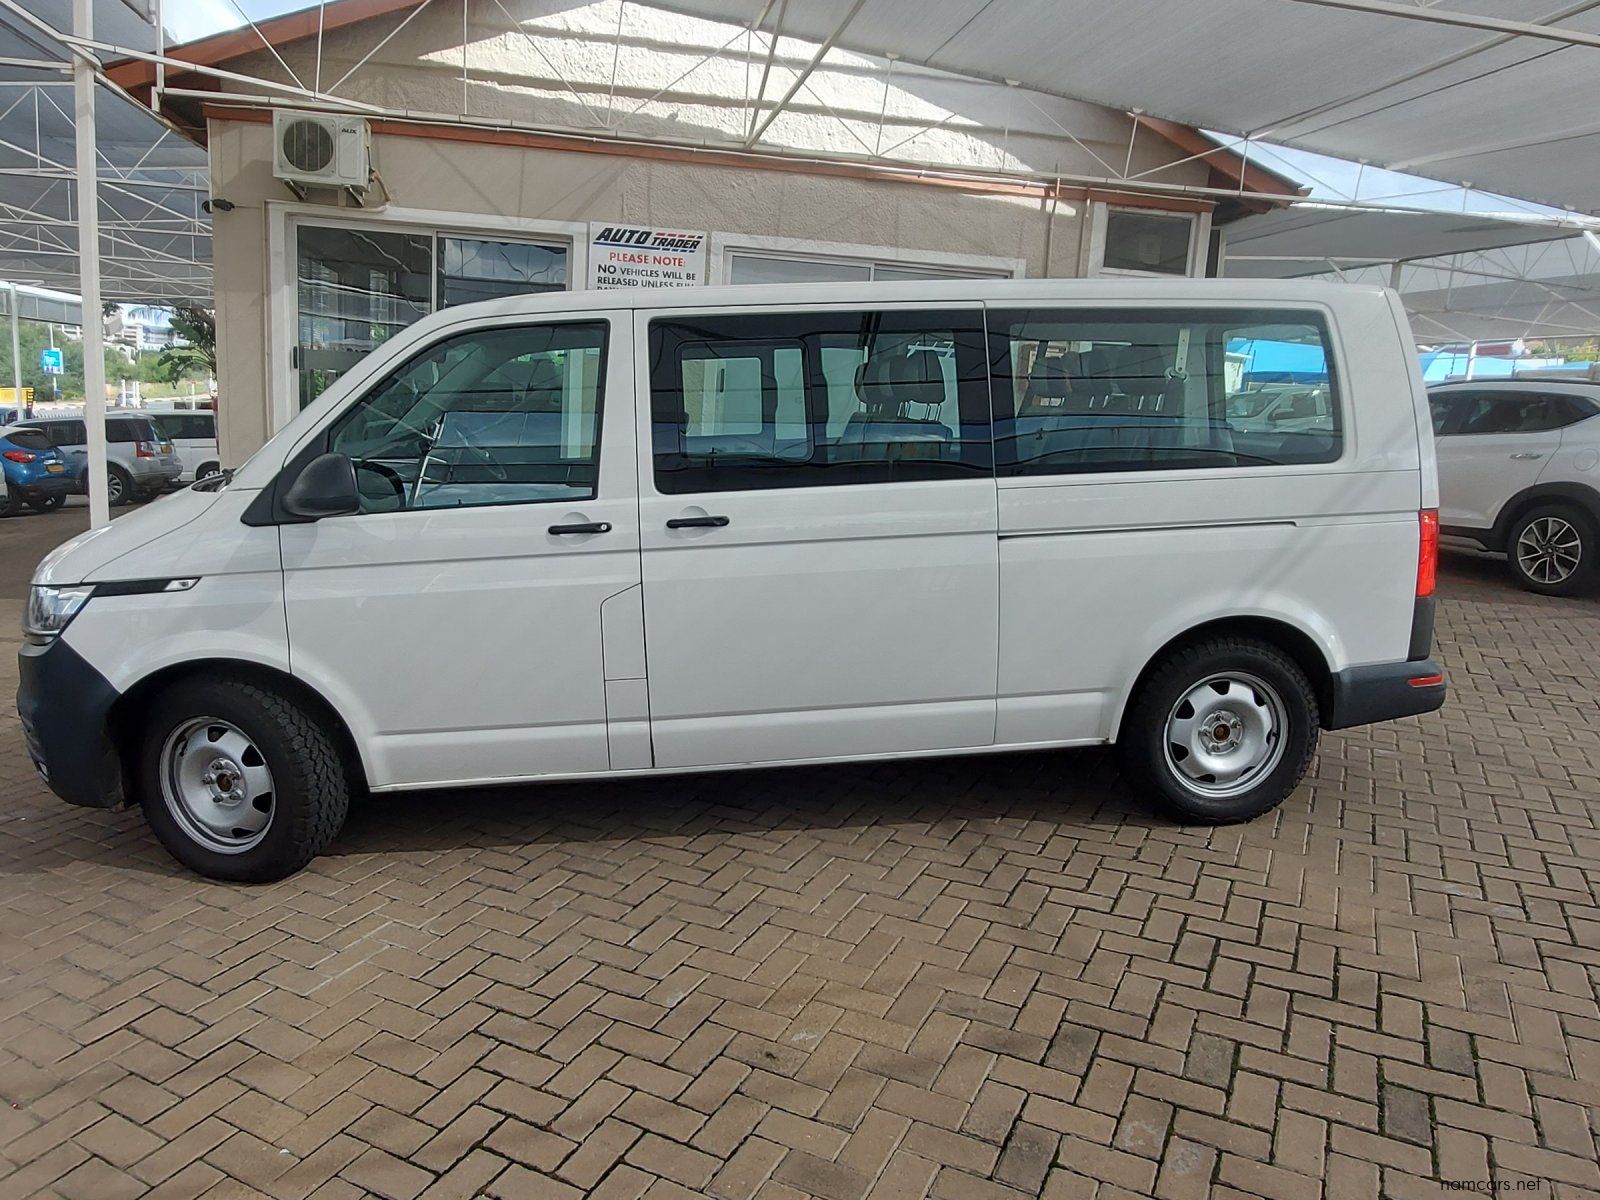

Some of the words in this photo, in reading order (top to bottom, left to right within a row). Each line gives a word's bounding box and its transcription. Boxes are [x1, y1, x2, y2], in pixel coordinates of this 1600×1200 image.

[595, 227, 652, 244] AUTO
[652, 237, 700, 249] TRADER
[609, 252, 650, 264] PLEASE
[597, 264, 617, 274] NO
[620, 267, 660, 278] VEHICLES
[662, 271, 683, 280] WILL
[686, 273, 697, 281] BE
[597, 276, 639, 287] RELEASED
